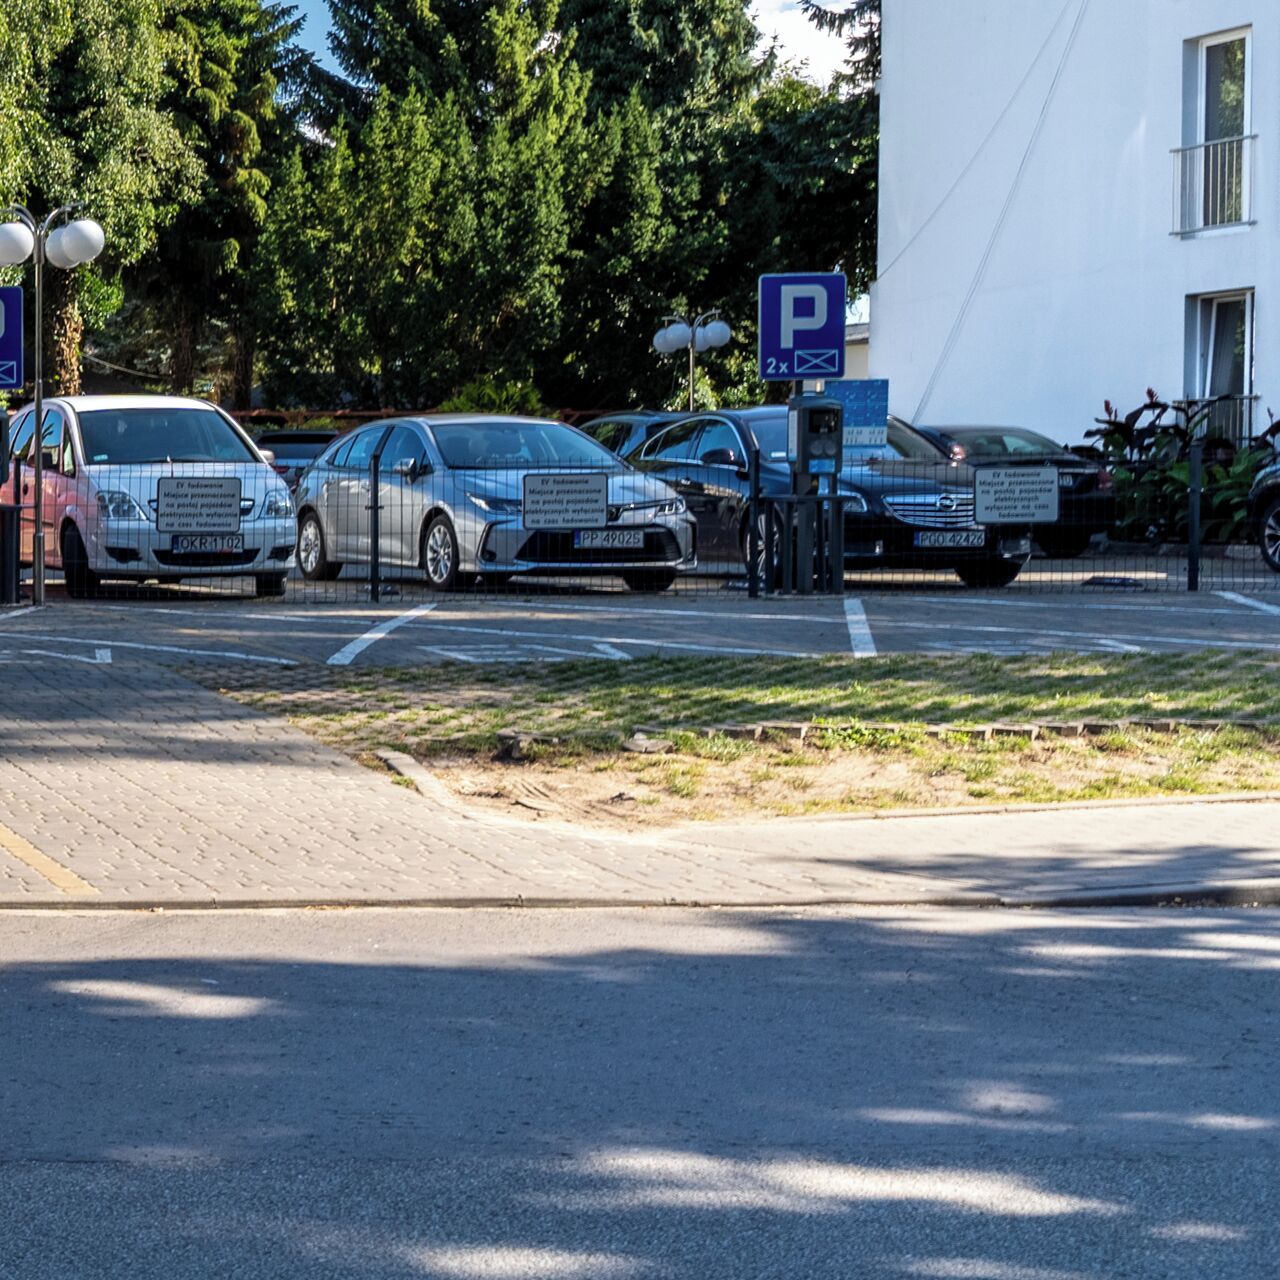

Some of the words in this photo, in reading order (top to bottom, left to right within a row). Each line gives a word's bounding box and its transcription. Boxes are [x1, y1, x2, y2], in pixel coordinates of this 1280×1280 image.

[780, 284, 828, 349] P
[181, 536, 208, 549] OKR
[582, 532, 599, 545] PP
[948, 533, 983, 545] 42426
